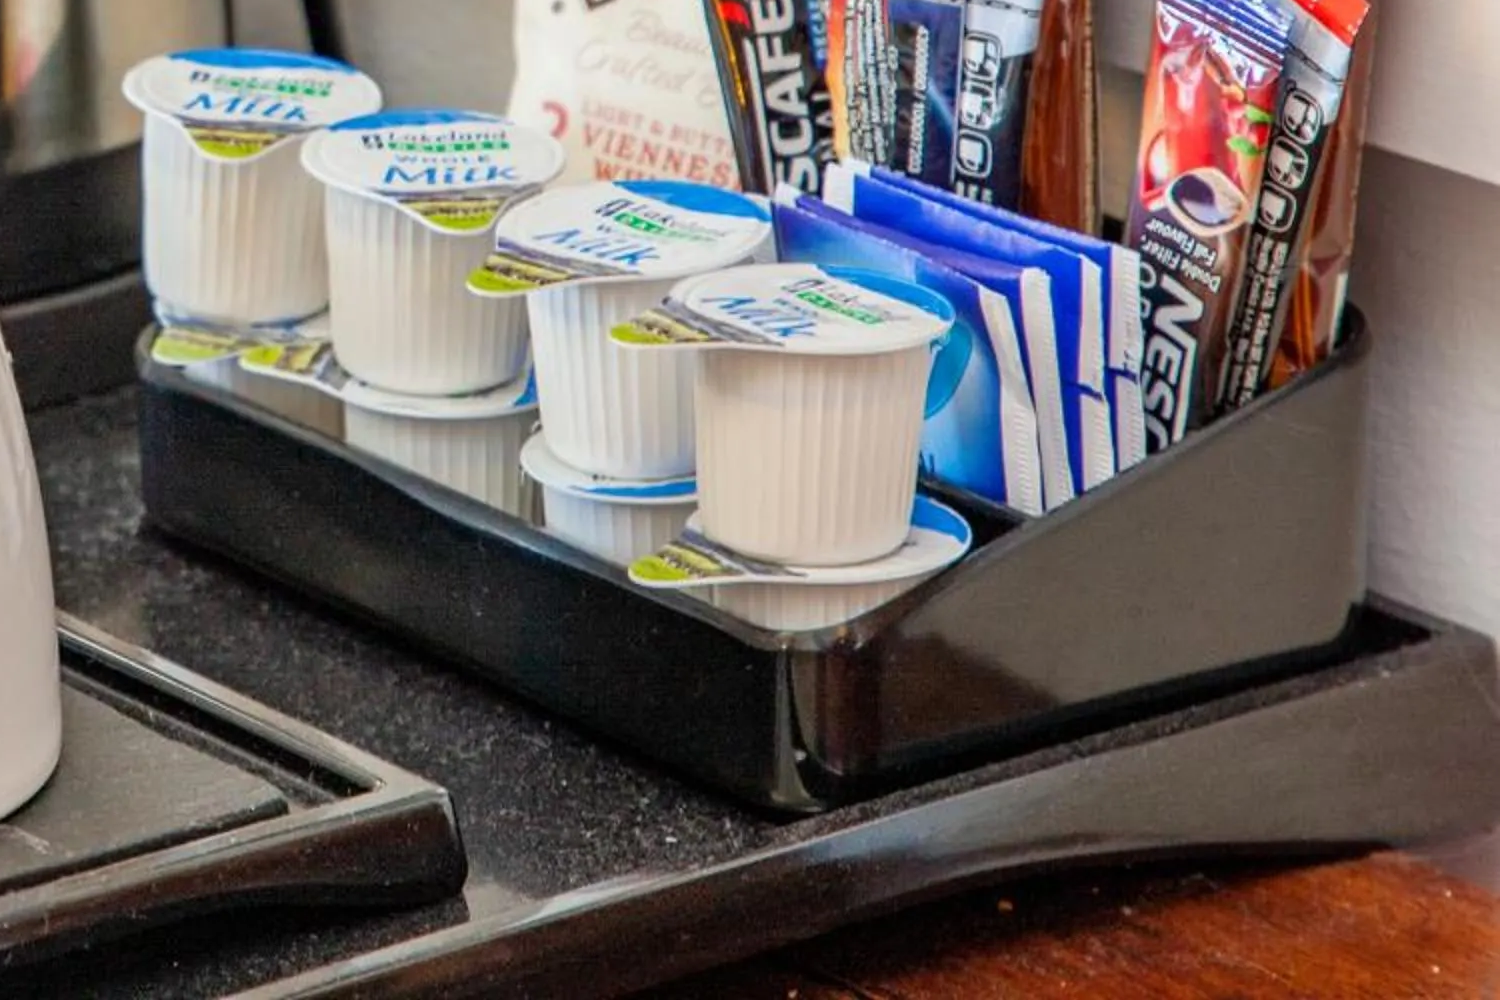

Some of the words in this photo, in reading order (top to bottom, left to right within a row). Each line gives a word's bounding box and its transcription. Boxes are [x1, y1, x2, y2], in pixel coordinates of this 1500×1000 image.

[182, 91, 308, 121] Milk
[581, 95, 646, 130] LIGHT
[382, 163, 520, 186] Milk
[581, 123, 741, 190] VIENNES
[532, 226, 662, 267] Milk
[1145, 217, 1196, 255] Flavour
[1193, 242, 1217, 268] Full
[1180, 258, 1221, 294] Double
[701, 295, 818, 338] Milk
